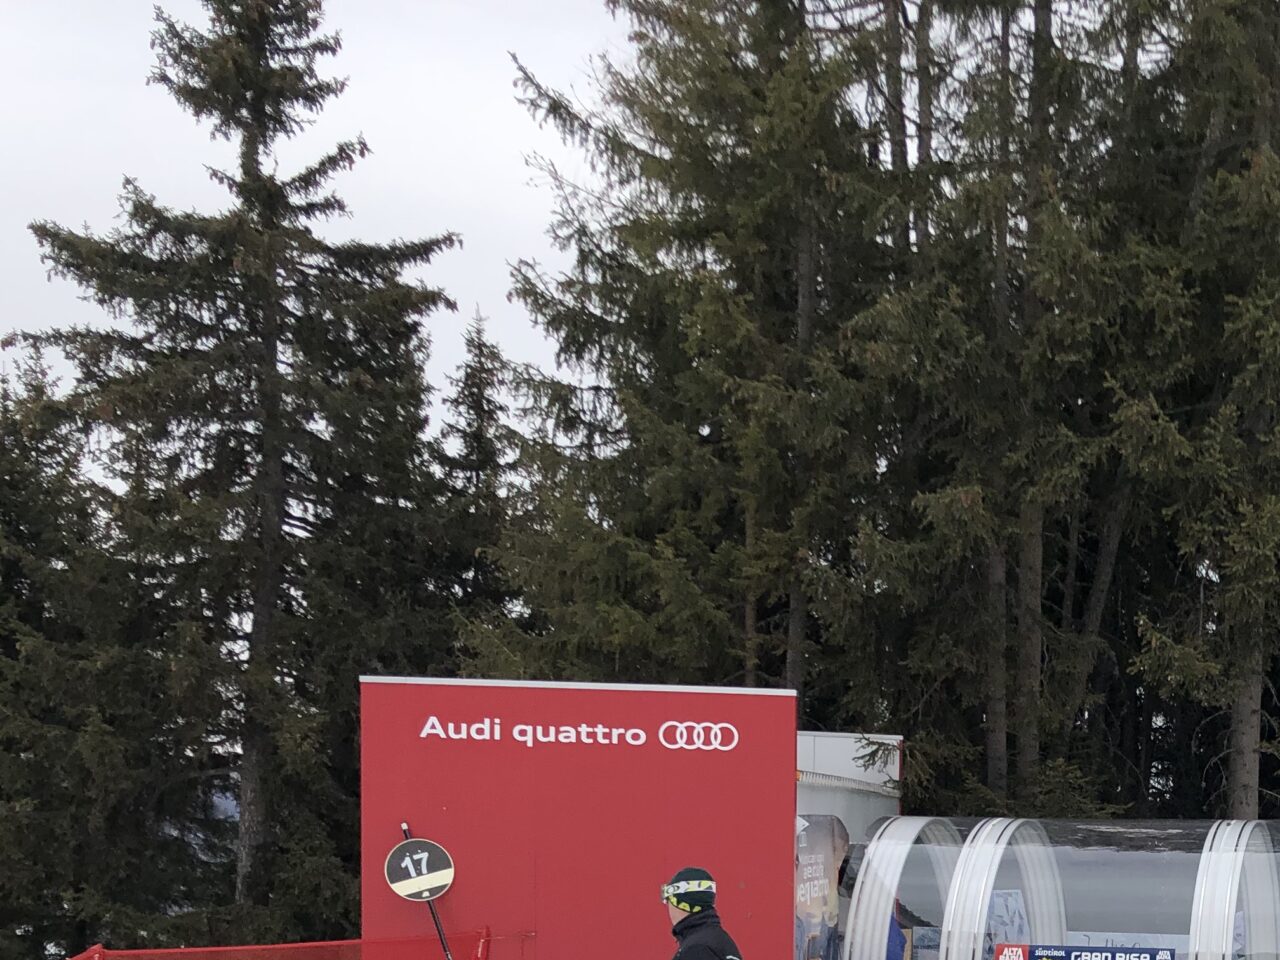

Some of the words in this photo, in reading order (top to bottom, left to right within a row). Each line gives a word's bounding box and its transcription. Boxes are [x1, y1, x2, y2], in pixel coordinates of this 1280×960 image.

[419, 715, 501, 740] Audi
[512, 722, 647, 747] quattro
[400, 852, 429, 878] 17
[1002, 947, 1023, 956] ALTA
